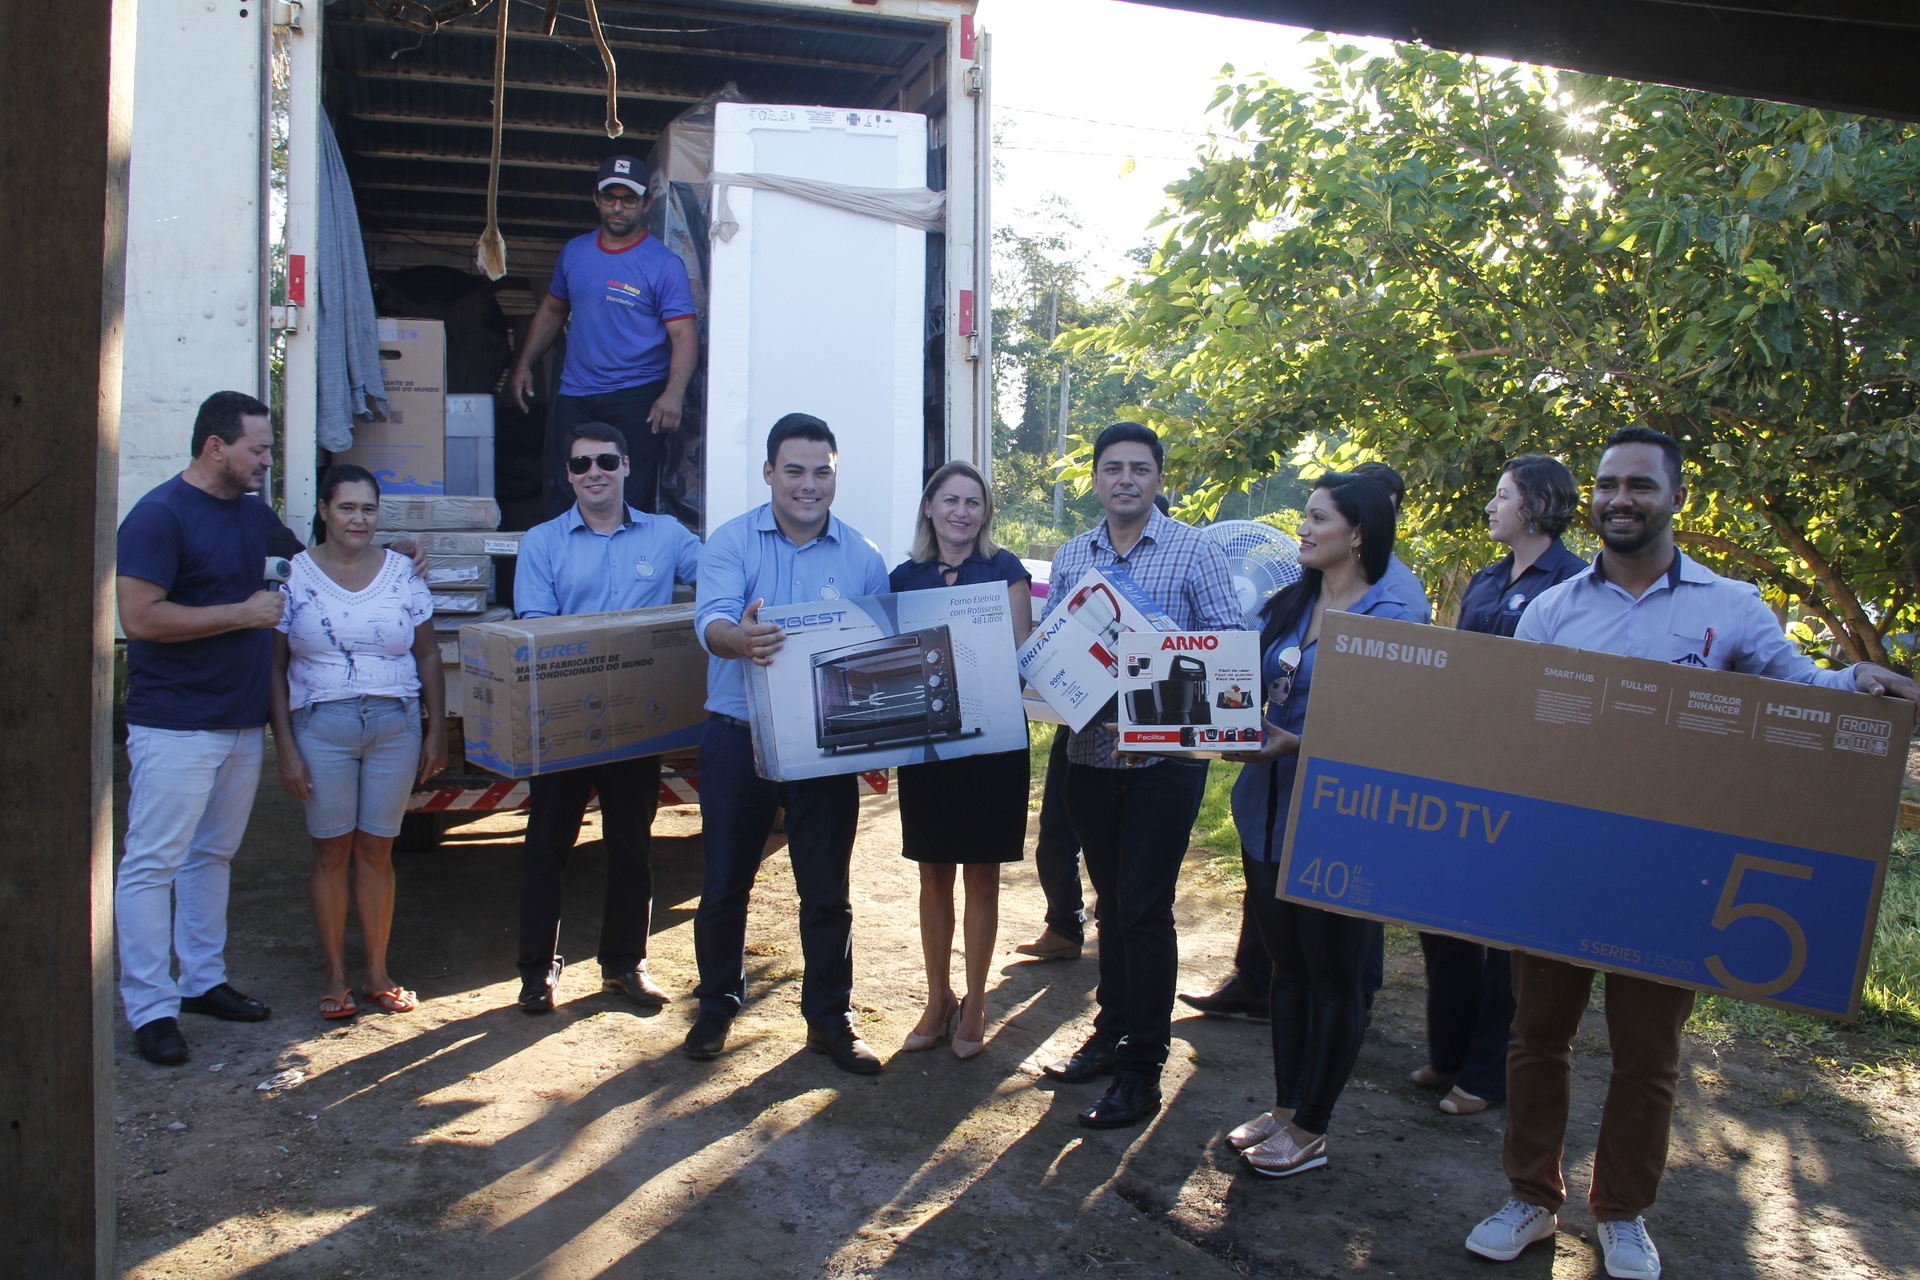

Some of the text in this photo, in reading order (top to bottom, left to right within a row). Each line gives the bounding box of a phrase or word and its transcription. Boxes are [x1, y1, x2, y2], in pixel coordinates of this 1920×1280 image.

[950, 593, 1001, 606] Forno Elétrico
[786, 610, 847, 628] BEST
[950, 609, 966, 617] com
[972, 614, 1003, 625] 48 Litros
[536, 641, 591, 660] GREE
[1160, 635, 1219, 651] ARNO
[1335, 633, 1448, 669] SAMSUNG
[550, 656, 606, 669] FABRICANTE
[608, 653, 621, 662] DE
[606, 662, 620, 671] DO
[621, 657, 655, 669] MUNDO
[1049, 668, 1066, 687] 900W
[1544, 667, 1595, 683] SMART HUB
[1620, 679, 1658, 693] FULL HD
[1069, 690, 1084, 704] 2,5L
[1689, 690, 1742, 707] WIDE COLOR
[1687, 700, 1740, 716] ENHANCER
[1766, 702, 1832, 724] HDMI
[1841, 718, 1888, 736] FRONT
[1312, 774, 1512, 844] Full HD TV
[1348, 895, 1371, 906] CLASS
[1704, 852, 1814, 998] 5
[1579, 938, 1694, 974] 5 SERIES J5290
